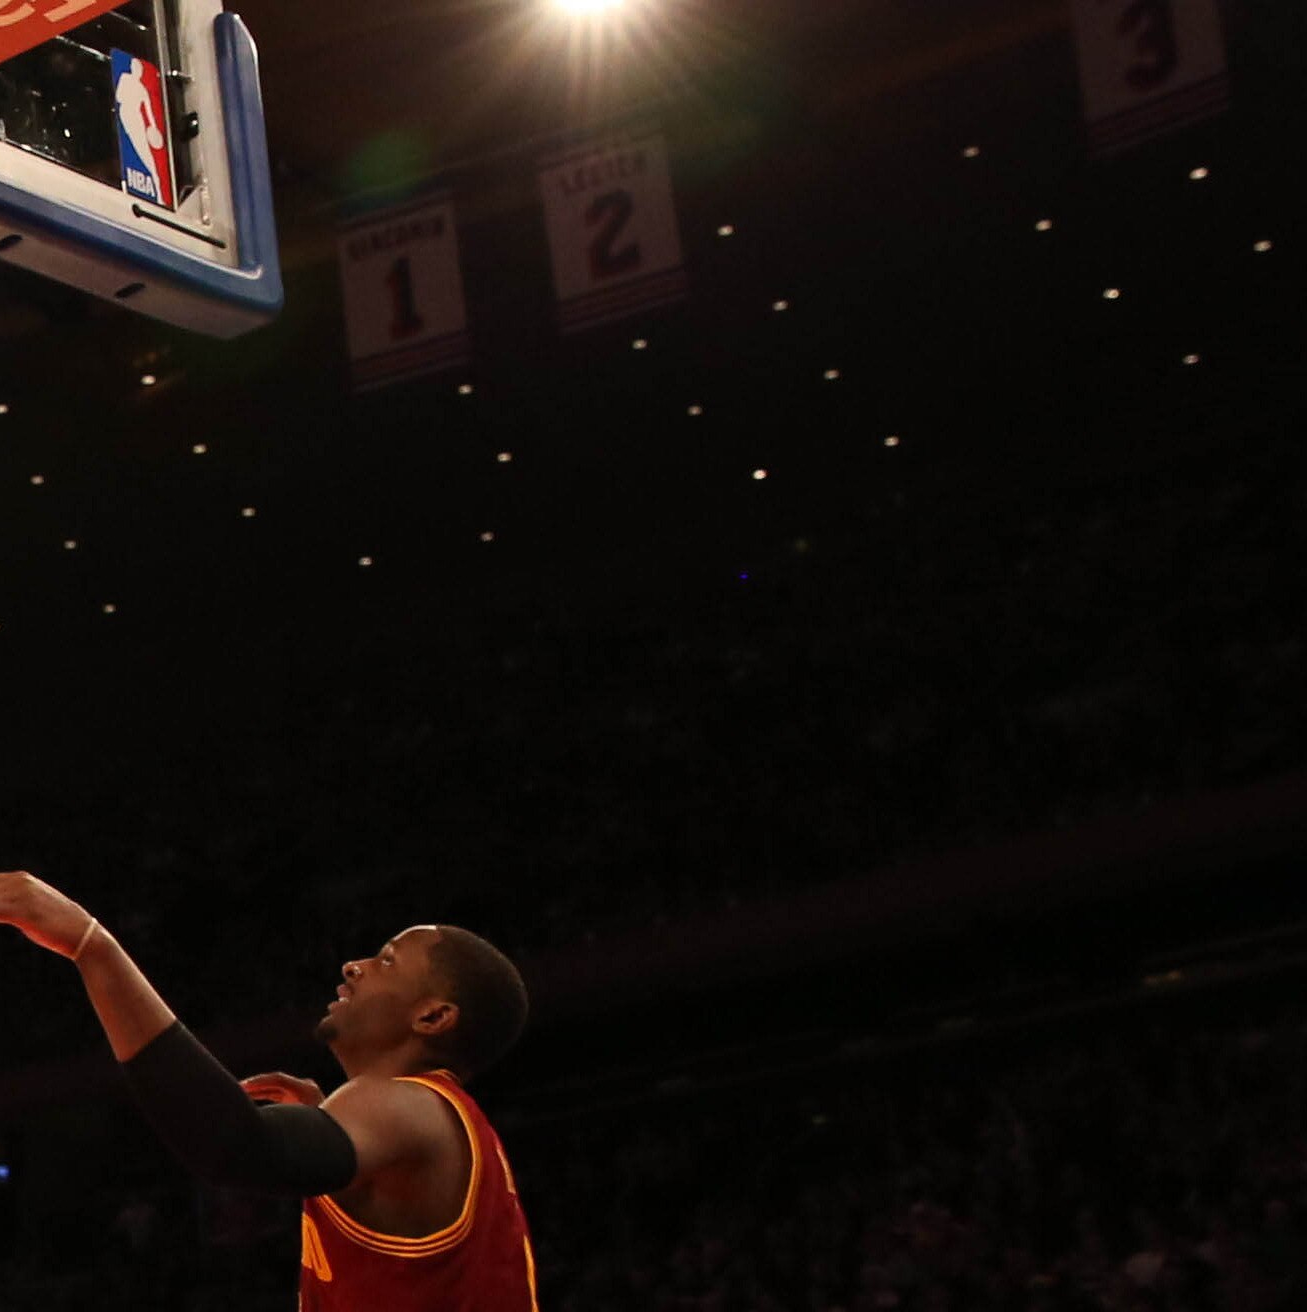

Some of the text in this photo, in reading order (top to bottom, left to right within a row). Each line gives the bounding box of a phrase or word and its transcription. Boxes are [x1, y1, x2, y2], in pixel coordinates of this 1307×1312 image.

[1117, 0, 1177, 91] 3
[125, 168, 158, 198] NBA
[584, 189, 642, 277] 2
[385, 257, 425, 341] 1
